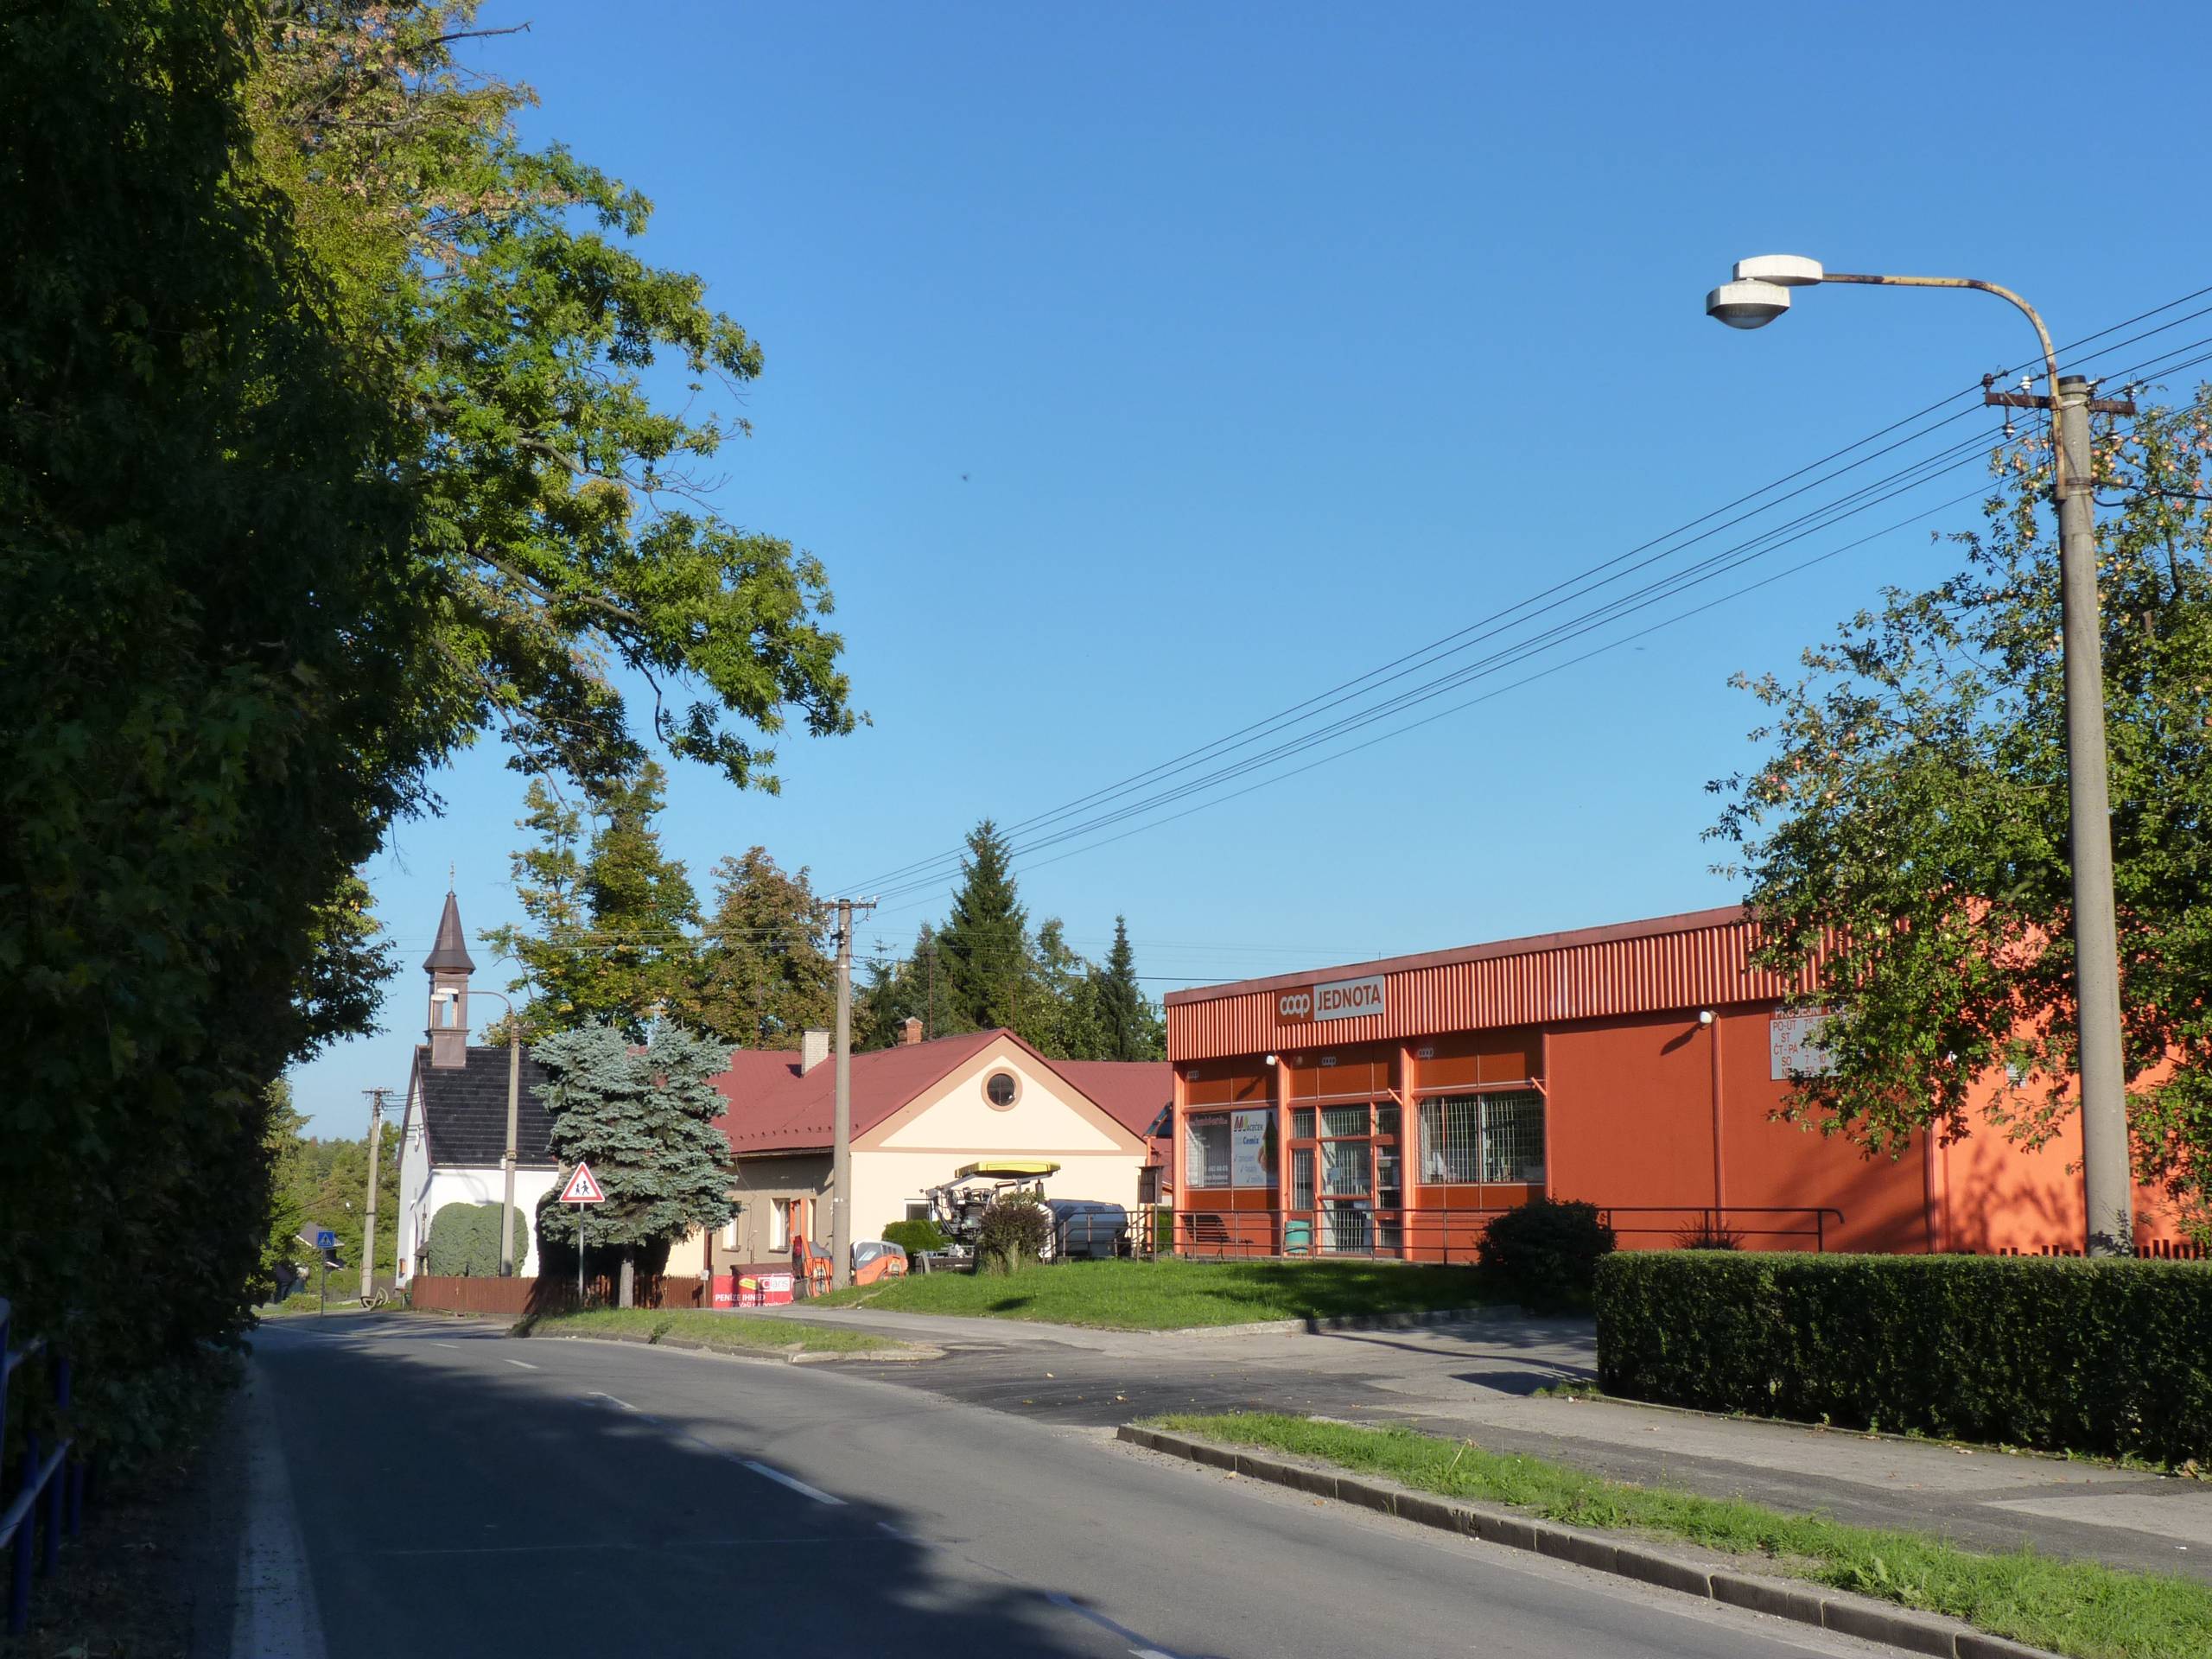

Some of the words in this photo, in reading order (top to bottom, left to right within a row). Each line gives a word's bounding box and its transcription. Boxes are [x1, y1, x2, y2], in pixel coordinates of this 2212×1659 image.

[1280, 994, 1311, 1019] coop
[1318, 984, 1382, 1012] JEDNOTA
[1781, 1033, 1790, 1043] ST
[1782, 1056, 1792, 1066] SO
